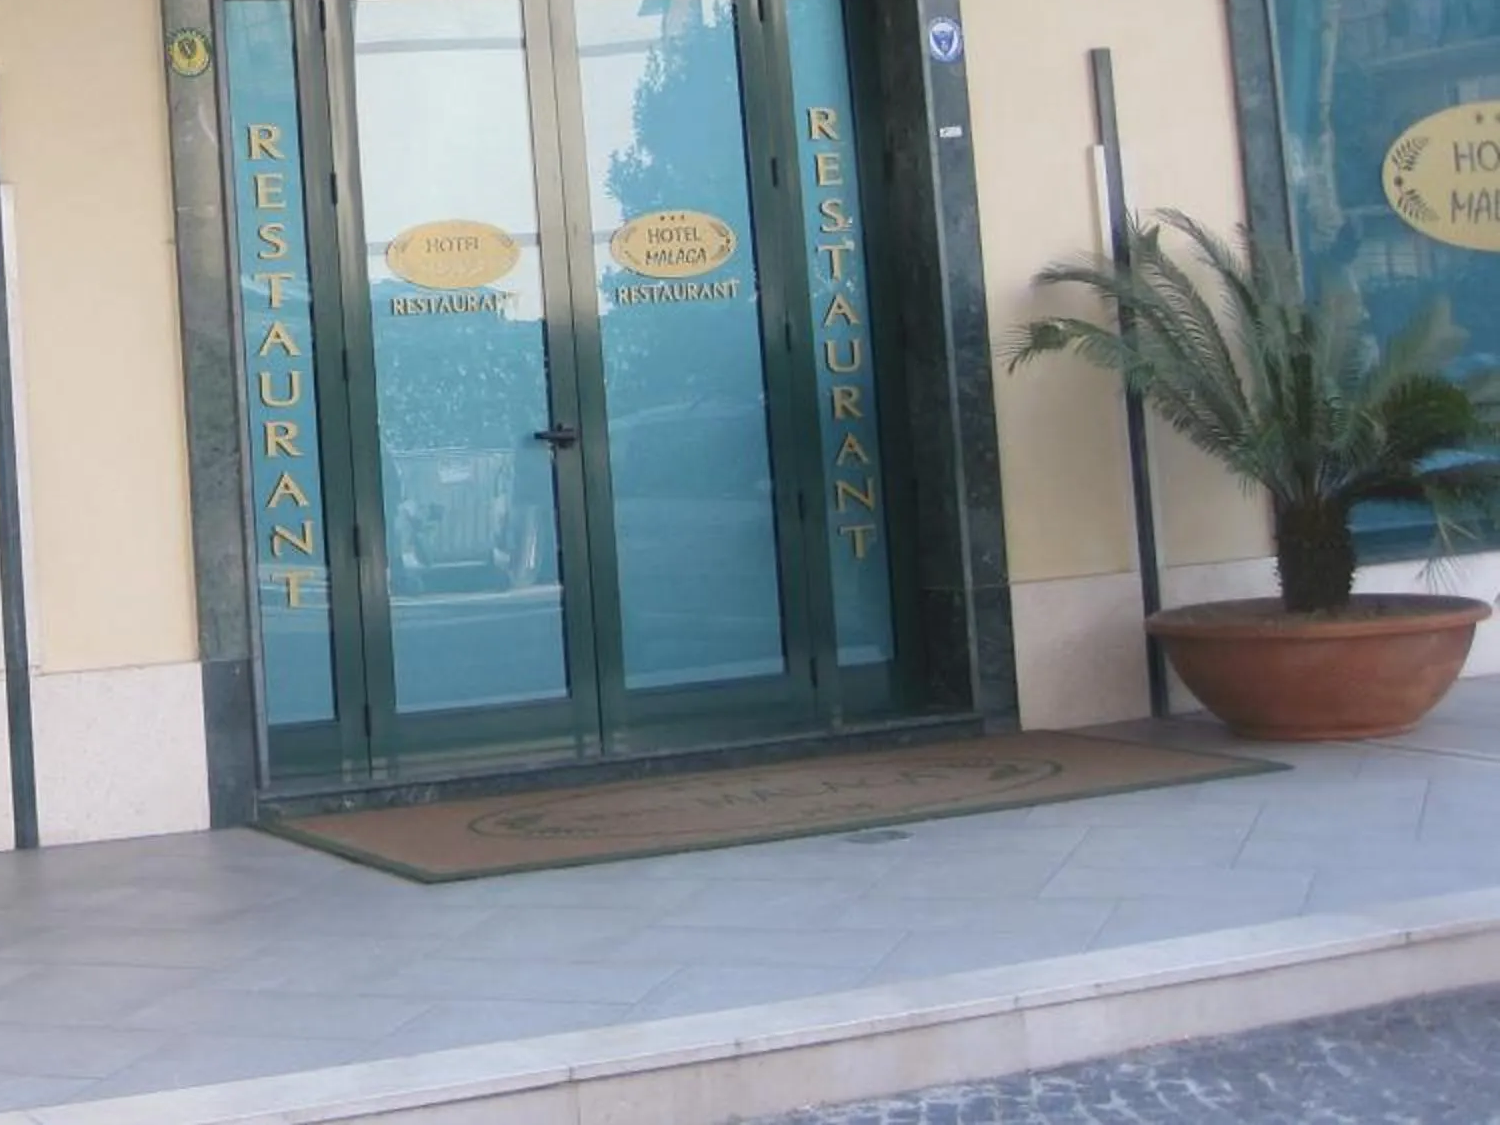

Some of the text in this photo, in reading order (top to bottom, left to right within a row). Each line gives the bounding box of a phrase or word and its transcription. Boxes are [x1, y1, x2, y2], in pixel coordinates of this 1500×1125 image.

[648, 225, 702, 244] HOTEL
[644, 245, 706, 266] MALAGA
[615, 278, 740, 305] RESTAURANT
[807, 106, 876, 559] RESTAURANT
[247, 123, 316, 608] RESTAURANT
